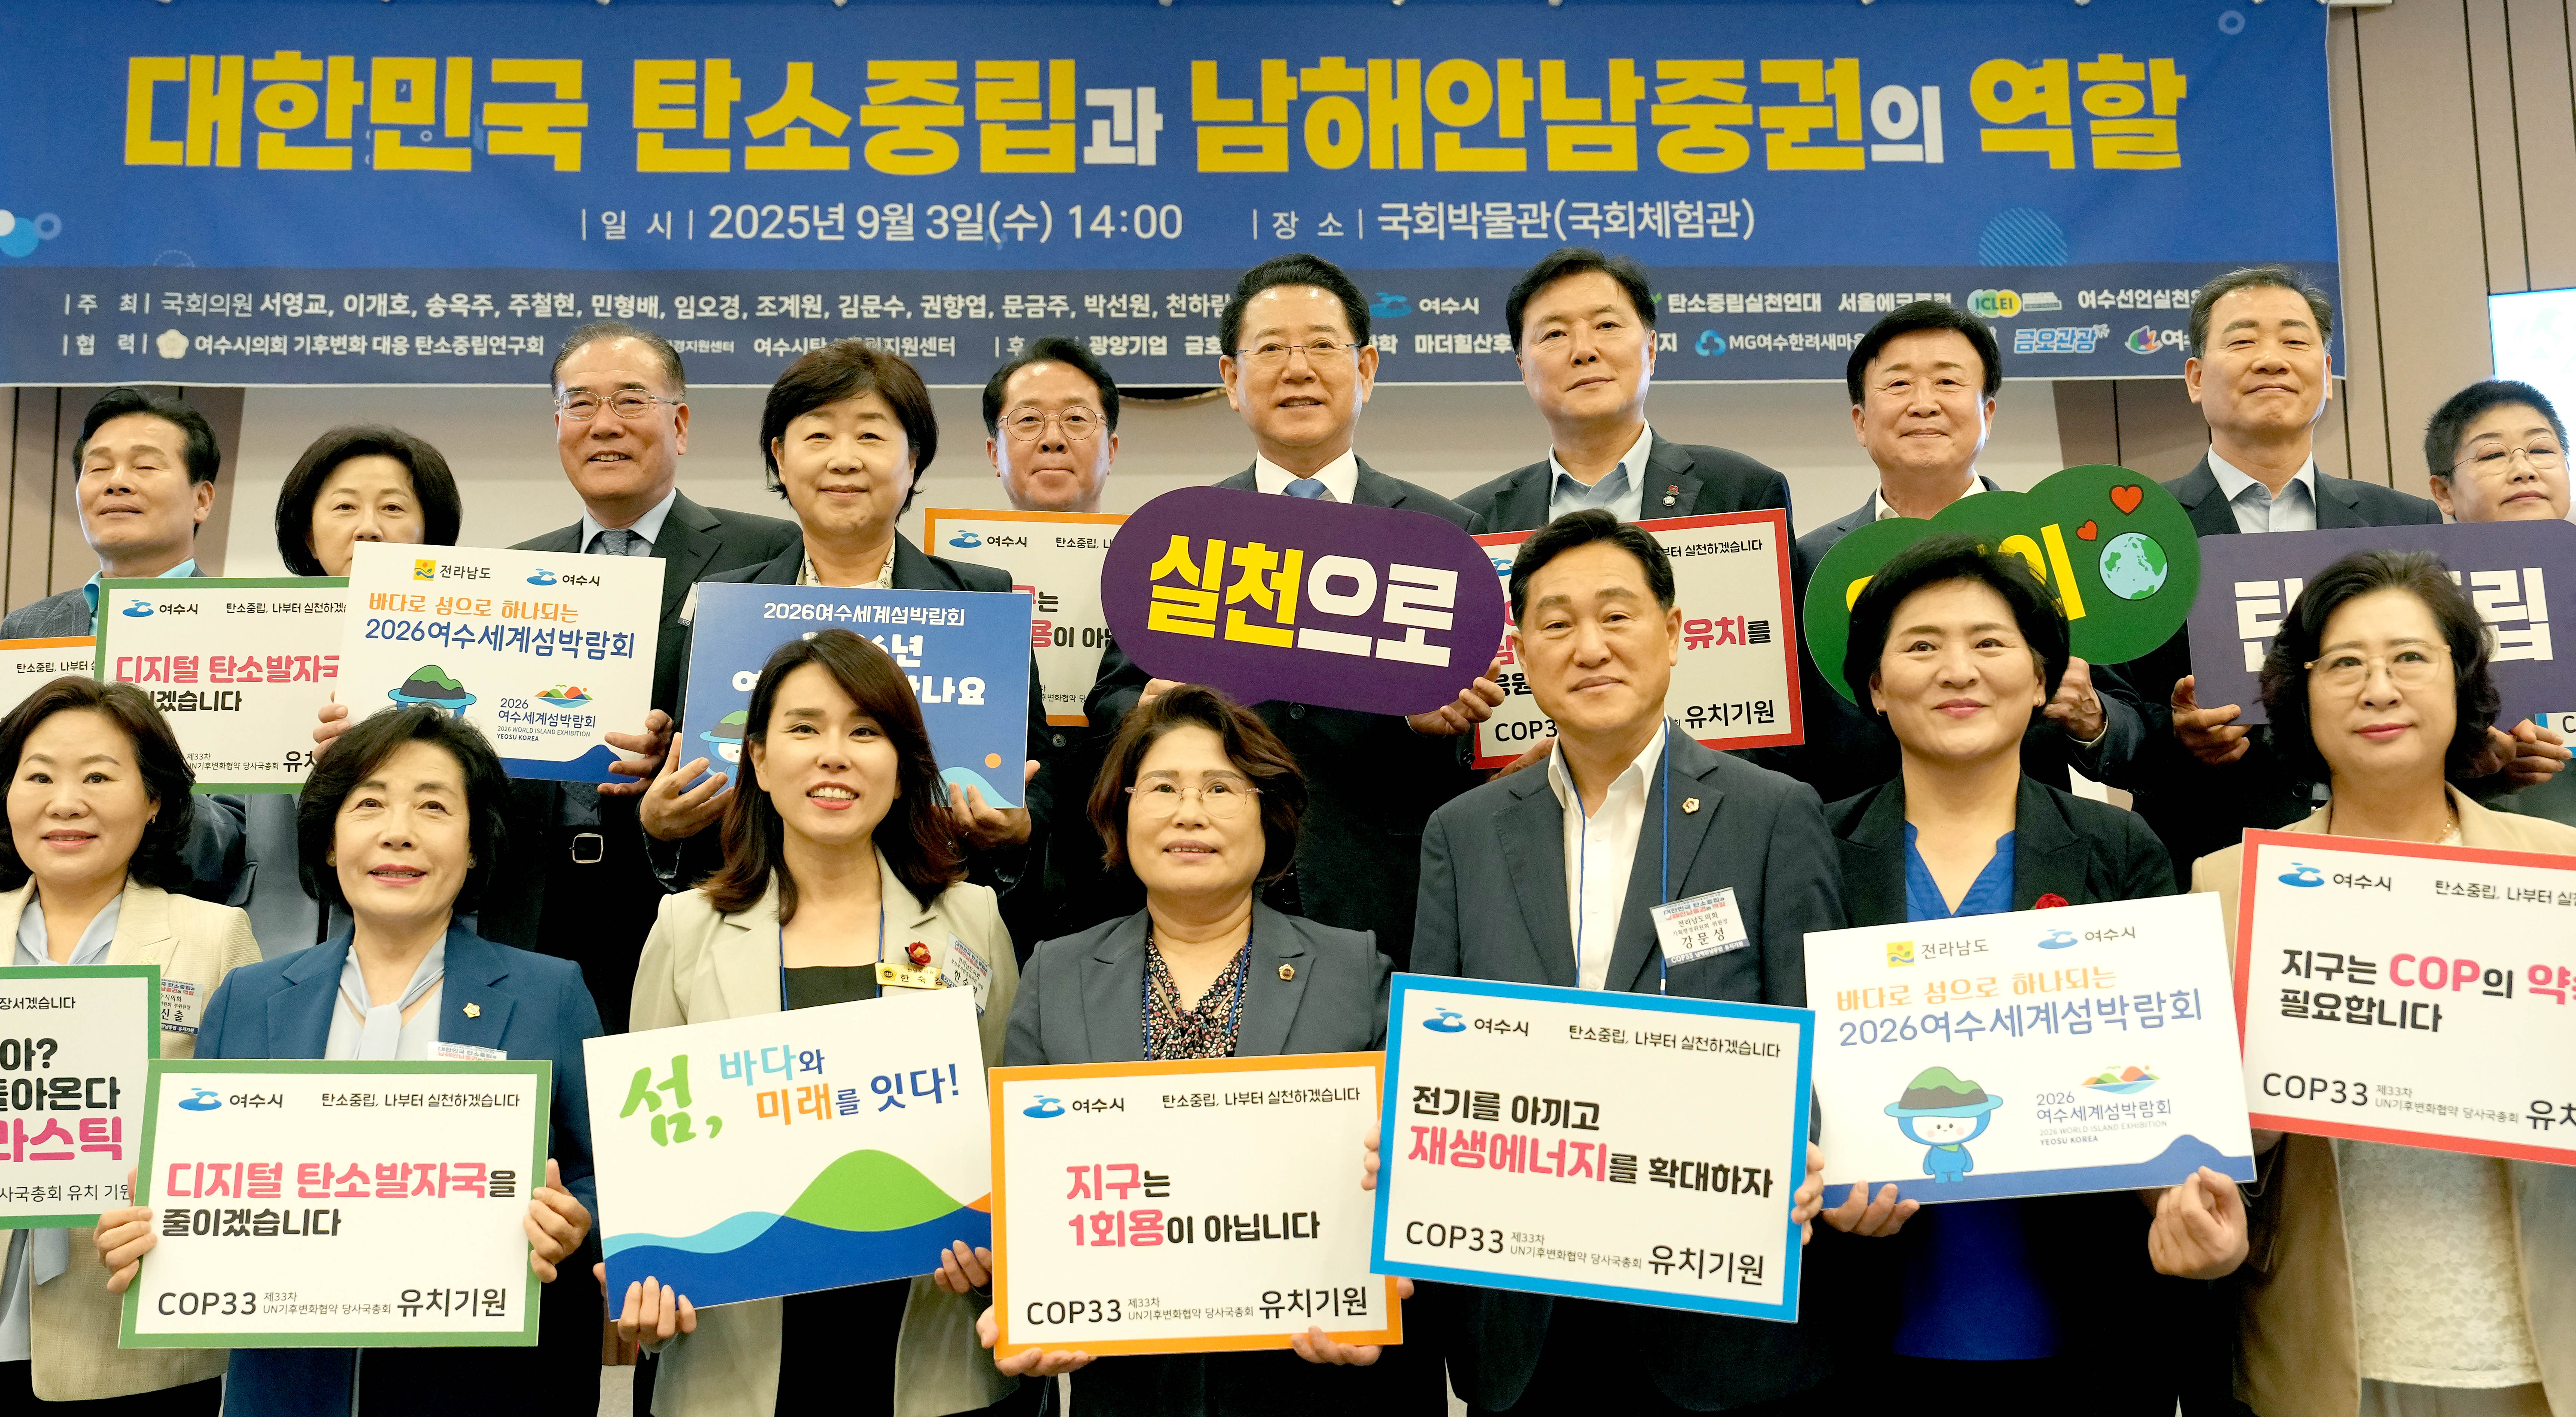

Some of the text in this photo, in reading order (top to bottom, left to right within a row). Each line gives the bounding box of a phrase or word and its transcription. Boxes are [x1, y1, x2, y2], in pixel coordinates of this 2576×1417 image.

[125, 50, 2186, 175] 대한민국 탄소중립과 남해안남중권의 역할
[601, 201, 1182, 243] 일 시 2025년 9월 3일(수) 14:00
[1273, 198, 1754, 241] 장 소 국회박물관(국회체험관)
[77, 292, 1157, 320] 주 최 국회의원 서영교, 이개호, 송옥주, 주철현, 민형배, 임오경, 조계원, 김문수, 권향엽, 문금주, 박선원,
[1419, 297, 1479, 315] 여수시
[1668, 293, 1821, 313] 탄소중립실천연대
[1975, 298, 2013, 310] ICLEI
[76, 333, 135, 355] 협 력
[195, 334, 544, 356] 여수시의회 기후변화 대응 탄소중립연구회
[1089, 336, 1167, 356] 광양기업
[2014, 328, 2097, 353] 금오관광
[987, 536, 1027, 548] 여수시
[1056, 537, 1098, 548] 탄소중립,
[1685, 539, 1762, 556] 실천하겠습니다
[440, 565, 490, 580] 전라남도
[562, 575, 599, 586] 여수시
[160, 604, 198, 614] 여수시
[227, 603, 301, 613] 탄소중립, 나부터
[369, 593, 578, 623] 바다로 섬으로 하나되는
[1147, 535, 1458, 667] 실천으로
[764, 603, 965, 626] 2026여수세계섬박람회
[365, 617, 634, 660] 2026여수세계섬박람회
[1684, 616, 1771, 650] 유치를
[16, 663, 57, 674] 탄소중립,
[61, 661, 88, 671] 나부터
[116, 656, 199, 683] 디지털
[500, 698, 528, 709] 2026
[1685, 700, 1774, 729] 유치기원
[499, 710, 596, 729] 여수세계섬박람회
[1496, 720, 1558, 742] COP3
[243, 762, 279, 770] 당사국총회
[2333, 874, 2391, 891] 여수시
[2507, 886, 2552, 904] 나부터
[1681, 927, 1724, 949] 강 문 성
[2085, 926, 2135, 942] 여수시
[1922, 939, 1988, 959] 전라남도
[901, 973, 909, 982] 한
[2282, 950, 2513, 999] 지구는 COP의
[1837, 967, 2116, 1011] 바다로 섬으로 하나되는
[1839, 988, 2201, 1046] 2026여수세계섬박람회
[2281, 989, 2442, 1032] 필요합니다
[1475, 1019, 1528, 1036] 여수시
[1570, 1025, 1780, 1058] 탄소중립, 나부터 실천하겠습니다
[720, 1045, 825, 1086] 바다와
[322, 1094, 520, 1107] 탄소중립, 나부터 실천하겠습니다
[620, 1054, 723, 1147] 섬,
[757, 1064, 959, 1125] 미래를 잇다!
[1163, 1088, 1360, 1108] 탄소중립, 나부터 실천하겠습니다
[2037, 1091, 2074, 1105] 2026
[2263, 1073, 2367, 1106] COP33
[2376, 1084, 2413, 1098] 제33차
[230, 1094, 283, 1108] 여수시
[1073, 1098, 1124, 1113] 여수시
[1413, 1086, 1599, 1131] 전기를 아끼고
[2037, 1099, 2171, 1123] 여수세계섬박람회
[2462, 1107, 2519, 1124] 당사국총회
[1409, 1126, 1773, 1198] 재생에너지를 확대하자
[167, 1162, 516, 1198] 디지털 탄소발자국을
[1067, 1163, 1170, 1200] 지구는
[67, 1185, 98, 1201] 유치
[163, 1208, 341, 1236] 줄이겠습니다
[1069, 1209, 1320, 1247] 1회용이 아닙니다
[1407, 1221, 1503, 1253] COP33
[1511, 1232, 1545, 1245] 제33차
[1511, 1245, 1641, 1269] UN기후변화협약 당사국총회
[1649, 1245, 1763, 1285] 유치기원
[159, 1292, 256, 1315] COP33
[264, 1292, 297, 1302] 제33차
[397, 1288, 505, 1317] 유치기원
[1128, 1297, 1160, 1308] 제33차
[1260, 1286, 1367, 1319] 유치기원
[264, 1304, 390, 1315] UN기후변화협약 당사국총회
[1027, 1300, 1121, 1325] COP33
[1129, 1306, 1253, 1320] UN기후변화협약 당사국총회
